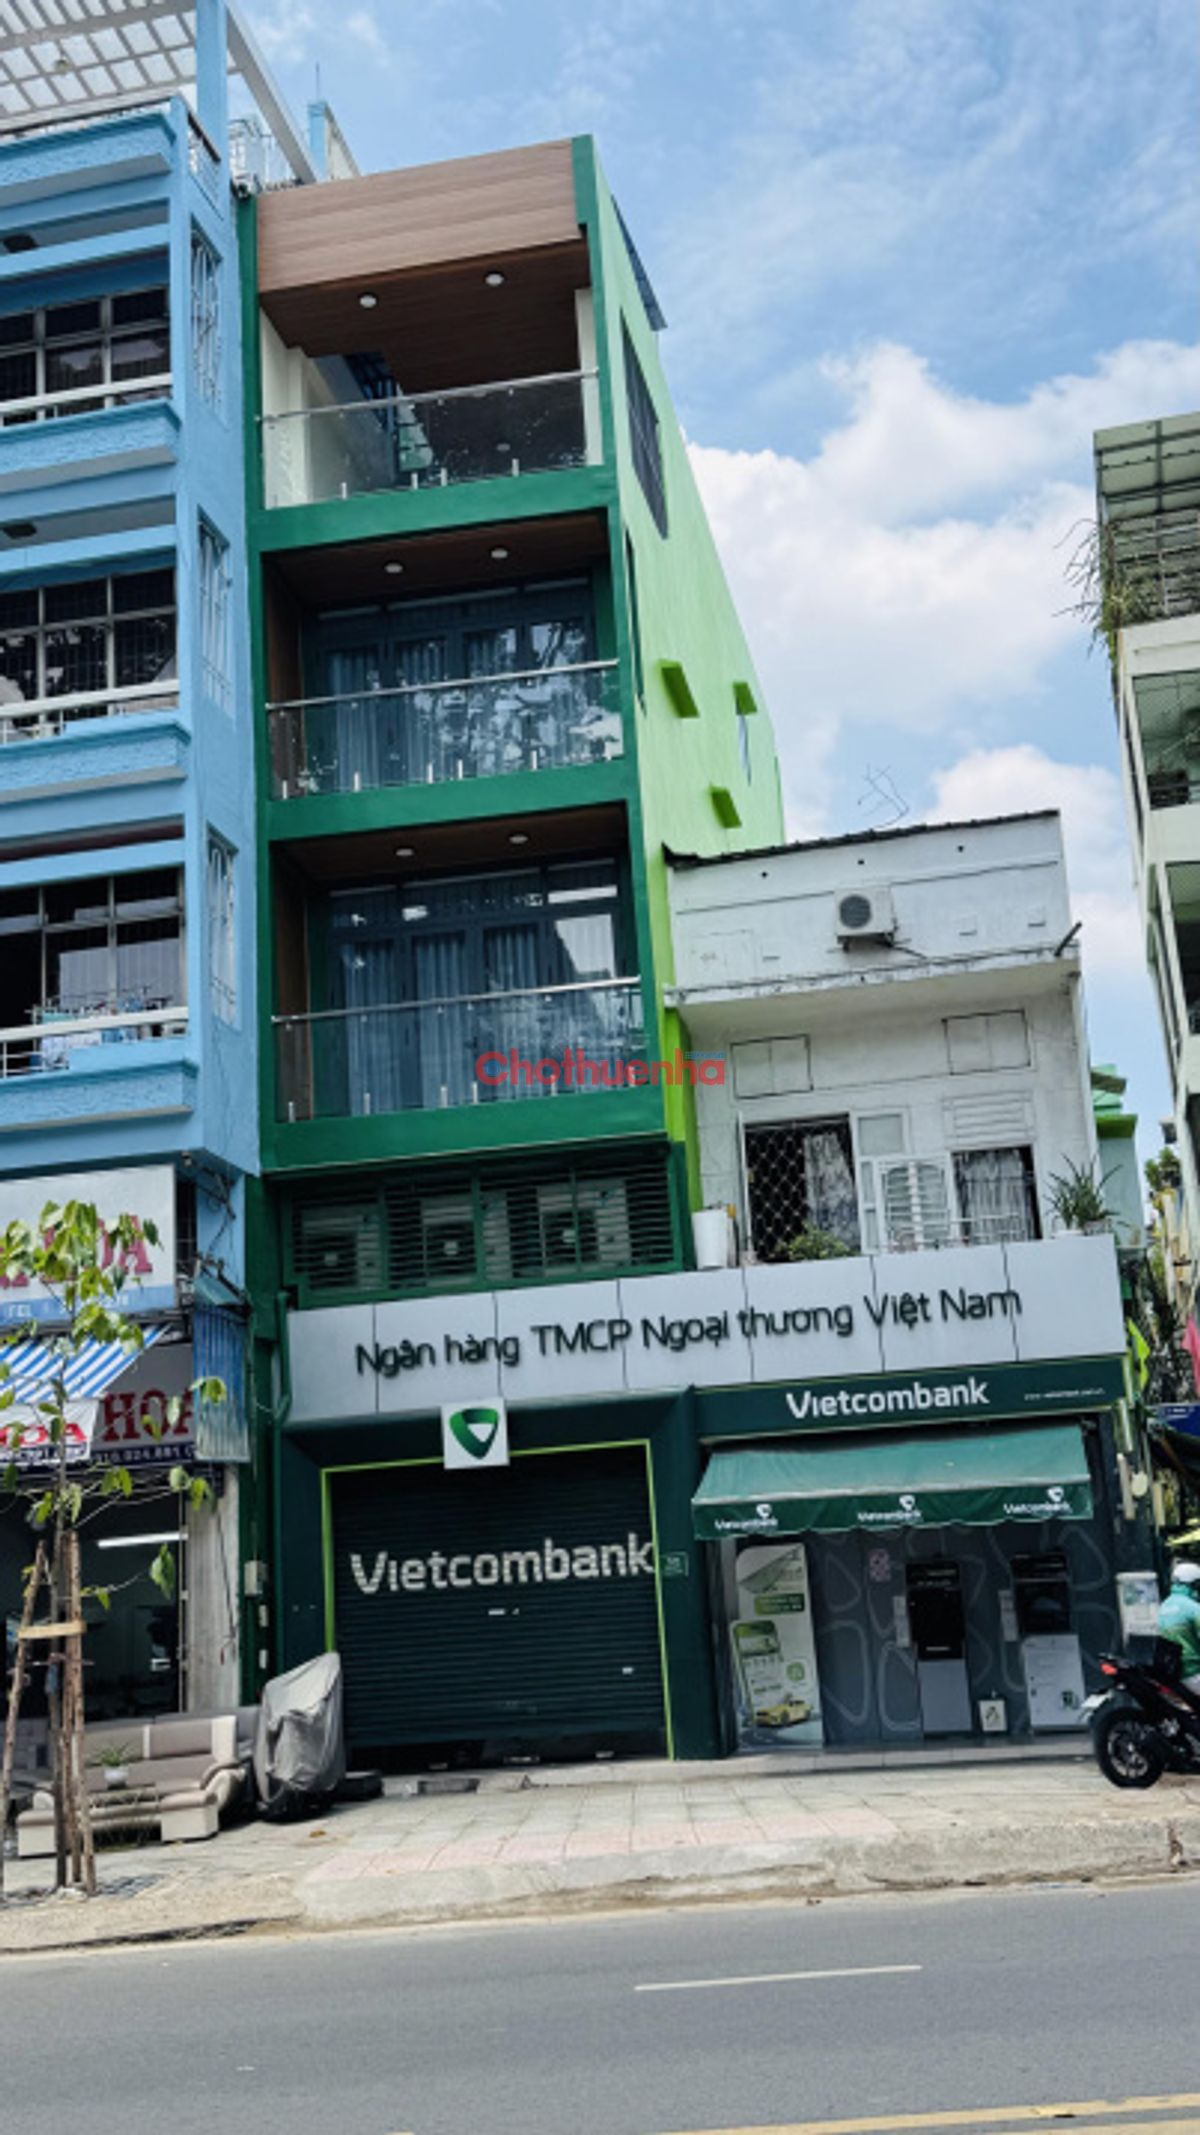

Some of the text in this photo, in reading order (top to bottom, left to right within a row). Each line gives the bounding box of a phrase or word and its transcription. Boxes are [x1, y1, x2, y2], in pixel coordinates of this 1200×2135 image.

[355, 1338, 437, 1378] Ngân
[444, 1333, 520, 1367] hàng
[529, 1319, 632, 1357] TMCP
[642, 1310, 730, 1352] Ngoại
[863, 1292, 932, 1331] Việt
[938, 1287, 1022, 1322] Nam
[785, 1376, 990, 1420] Vietcombank
[350, 1532, 656, 1594] Vietcombank
